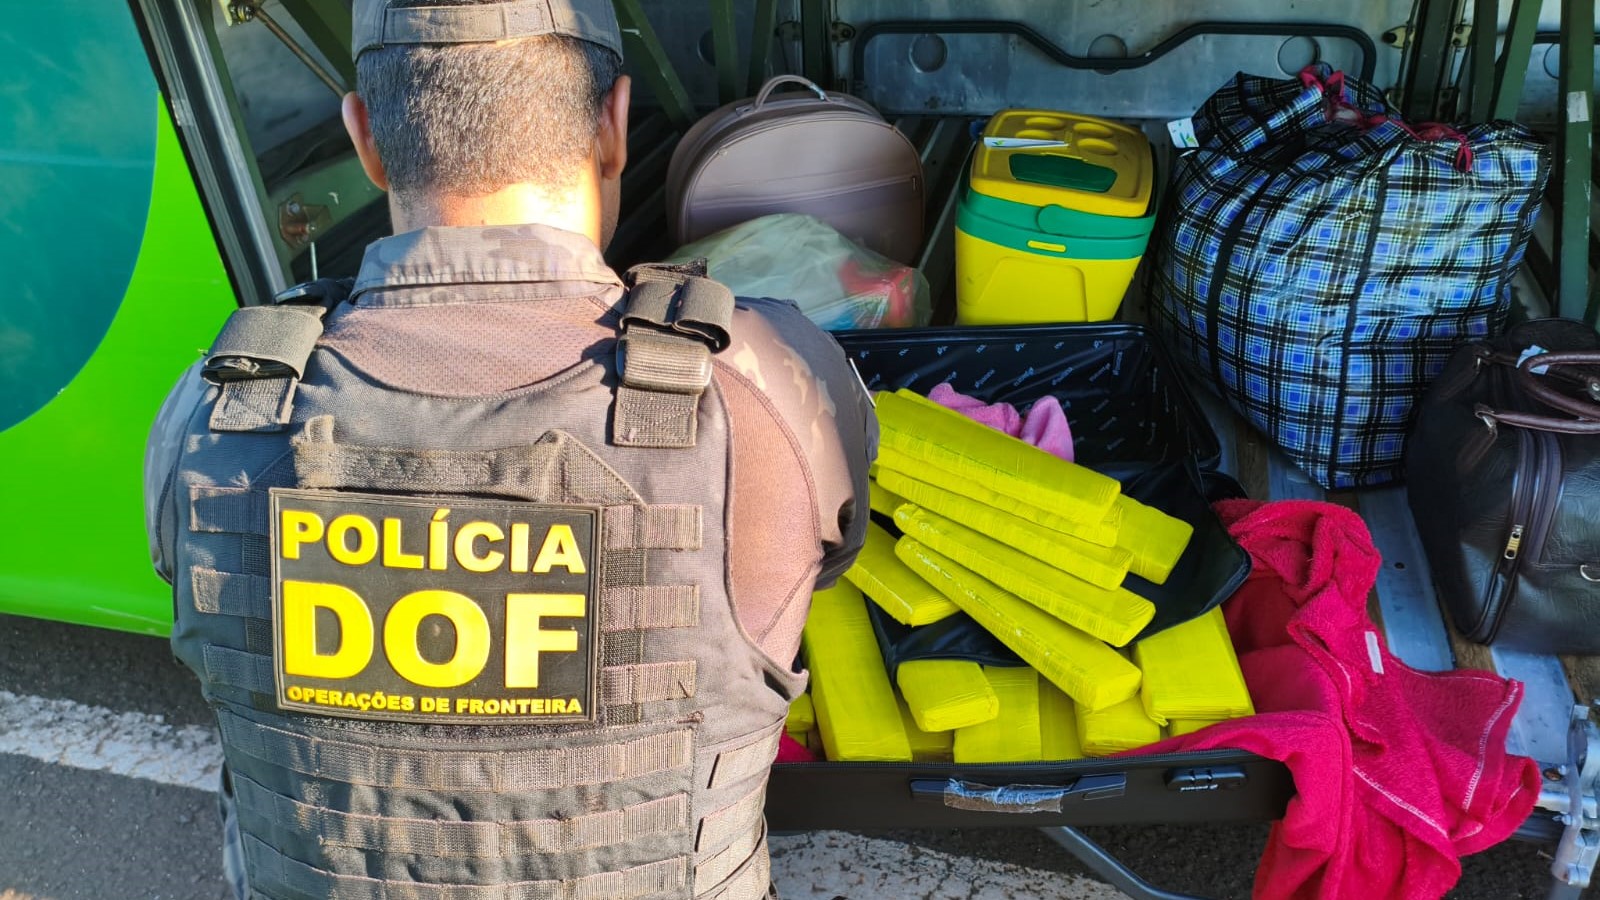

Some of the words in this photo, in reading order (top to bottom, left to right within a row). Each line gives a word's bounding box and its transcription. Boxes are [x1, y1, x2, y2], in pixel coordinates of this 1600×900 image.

[281, 507, 586, 574] POLÍCIA
[283, 579, 586, 689] DOF
[287, 685, 416, 712] OPERAÇÕES
[421, 696, 450, 713] DE
[455, 697, 582, 715] FRONTEIRA
